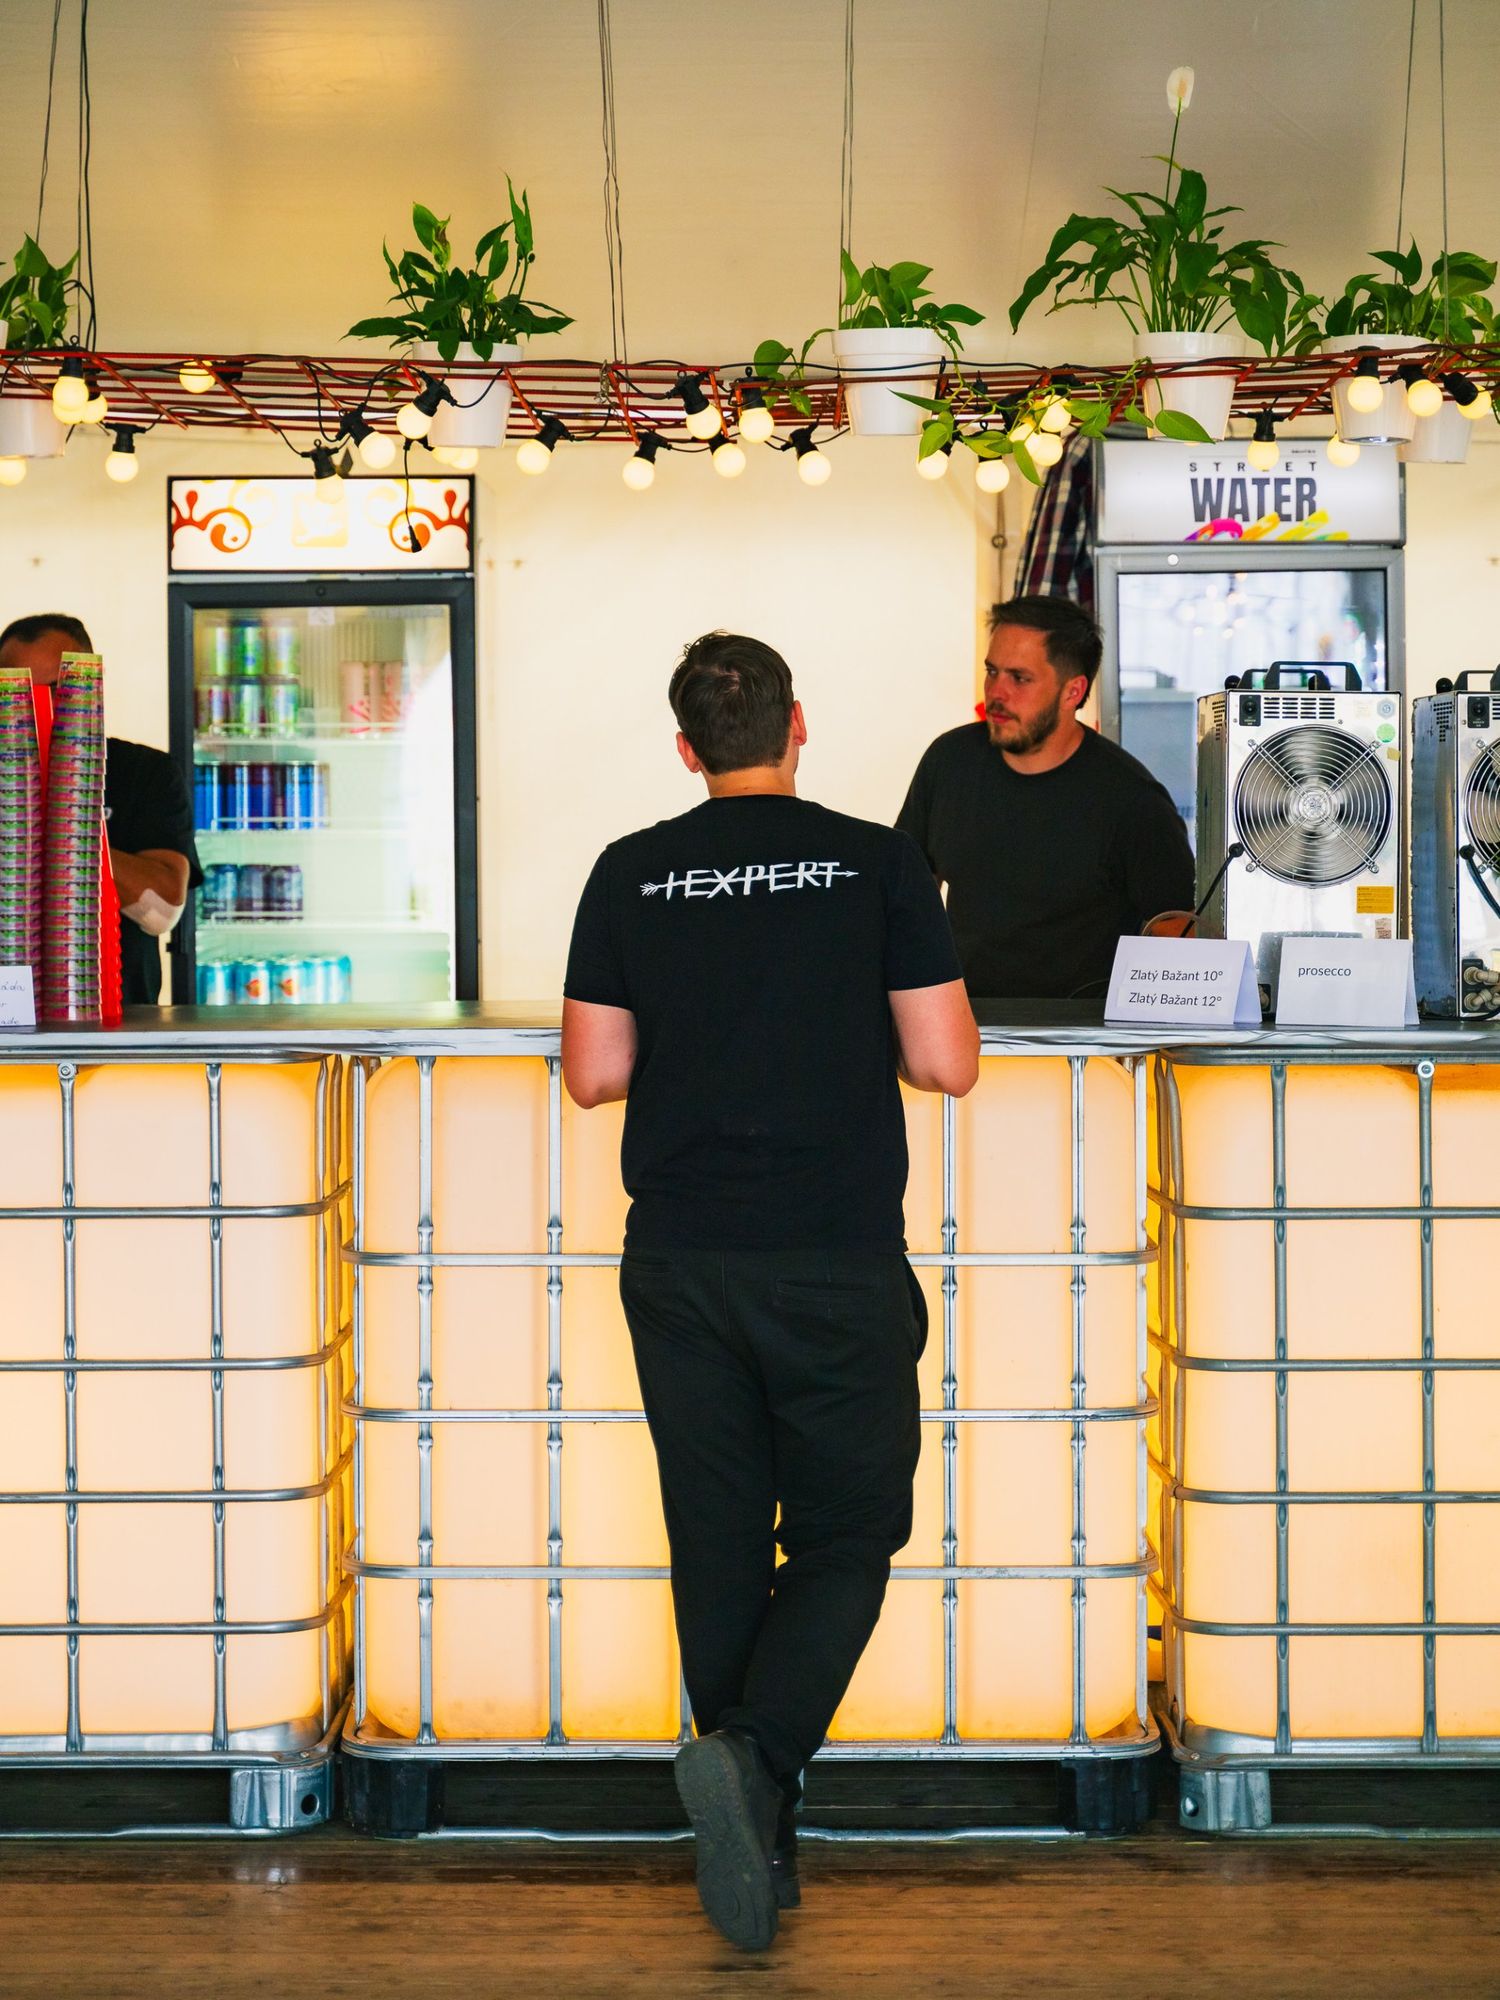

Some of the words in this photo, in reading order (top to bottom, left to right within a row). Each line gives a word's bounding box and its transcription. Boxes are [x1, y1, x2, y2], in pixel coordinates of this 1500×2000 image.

[1190, 462, 1317, 472] STRET
[1190, 477, 1317, 523] WATER
[1130, 968, 1159, 983] Zlatý
[1161, 969, 1200, 982] Bažant
[1203, 970, 1224, 982] 10°
[1298, 966, 1352, 978] prosecco
[1128, 991, 1157, 1006] Zlatý
[1159, 994, 1199, 1006] Bažant
[1201, 996, 1222, 1007] 12°
